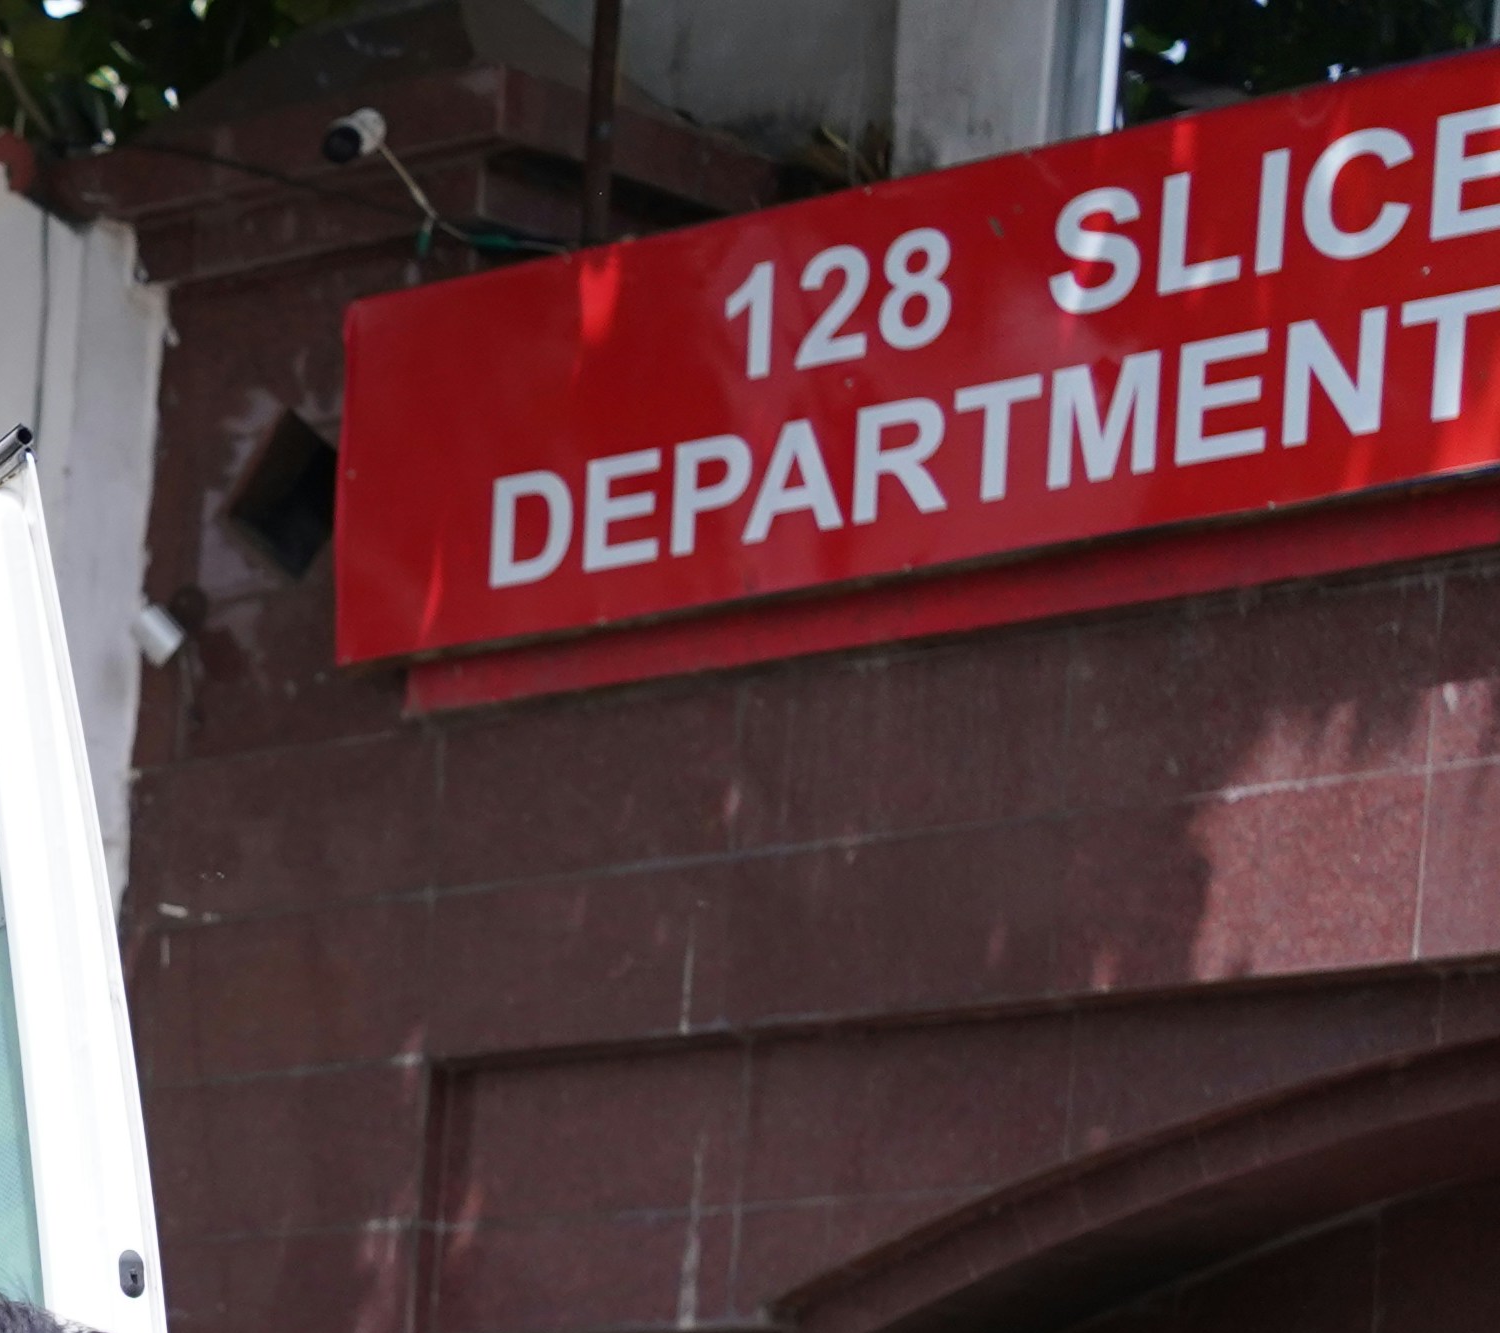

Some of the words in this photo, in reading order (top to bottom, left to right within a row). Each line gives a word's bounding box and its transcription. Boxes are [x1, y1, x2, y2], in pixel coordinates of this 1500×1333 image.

[724, 228, 952, 381] 128
[1048, 104, 1500, 315] SLICE
[488, 286, 1500, 590] DEPARTMENT
